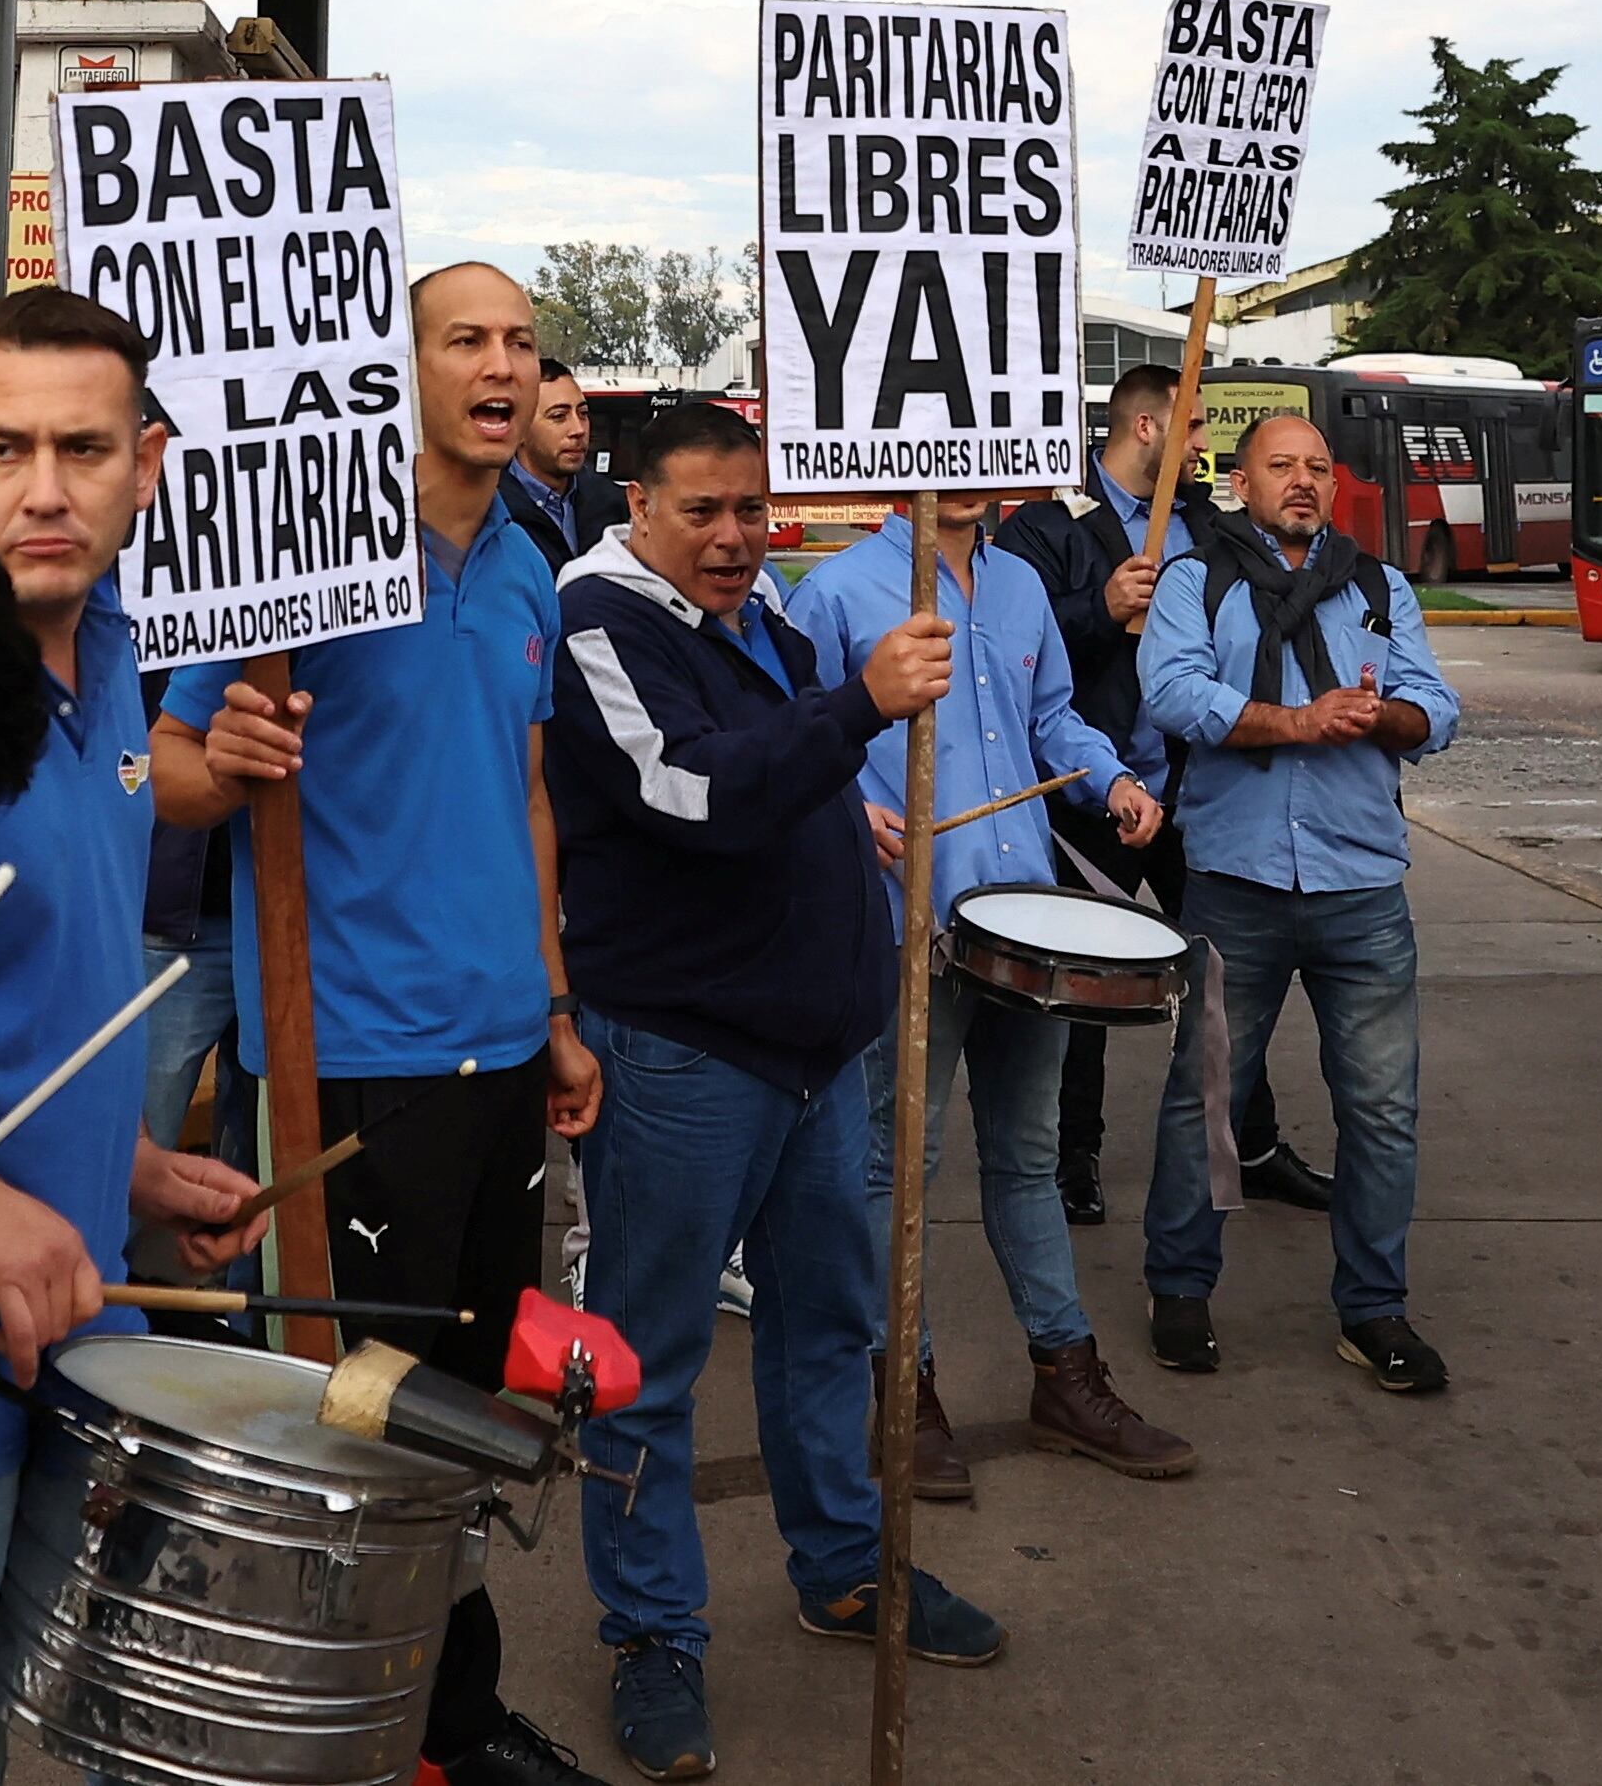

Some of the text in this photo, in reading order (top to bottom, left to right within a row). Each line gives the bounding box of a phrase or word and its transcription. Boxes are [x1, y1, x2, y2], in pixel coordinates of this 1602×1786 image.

[774, 12, 1063, 126] PARITARIAS
[1157, 62, 1308, 135] CON EL CEPO
[72, 96, 391, 227] BASTA
[777, 133, 1062, 238] LIBRES
[1147, 133, 1301, 171] A LAS
[1135, 164, 1293, 247] PARITARIAS
[216, 234, 275, 353] EL
[282, 226, 393, 347] CEPO
[1132, 242, 1281, 275] TRABAJADORES LINEA 60
[775, 249, 1064, 431] YA!!
[223, 362, 401, 432] LAS
[780, 438, 1072, 480] TRABAJADORES LINEA 60
[119, 422, 407, 599] ARITARIAS
[1517, 491, 1573, 507] MONSA
[317, 579, 380, 632] LINEA
[385, 574, 412, 618] 60
